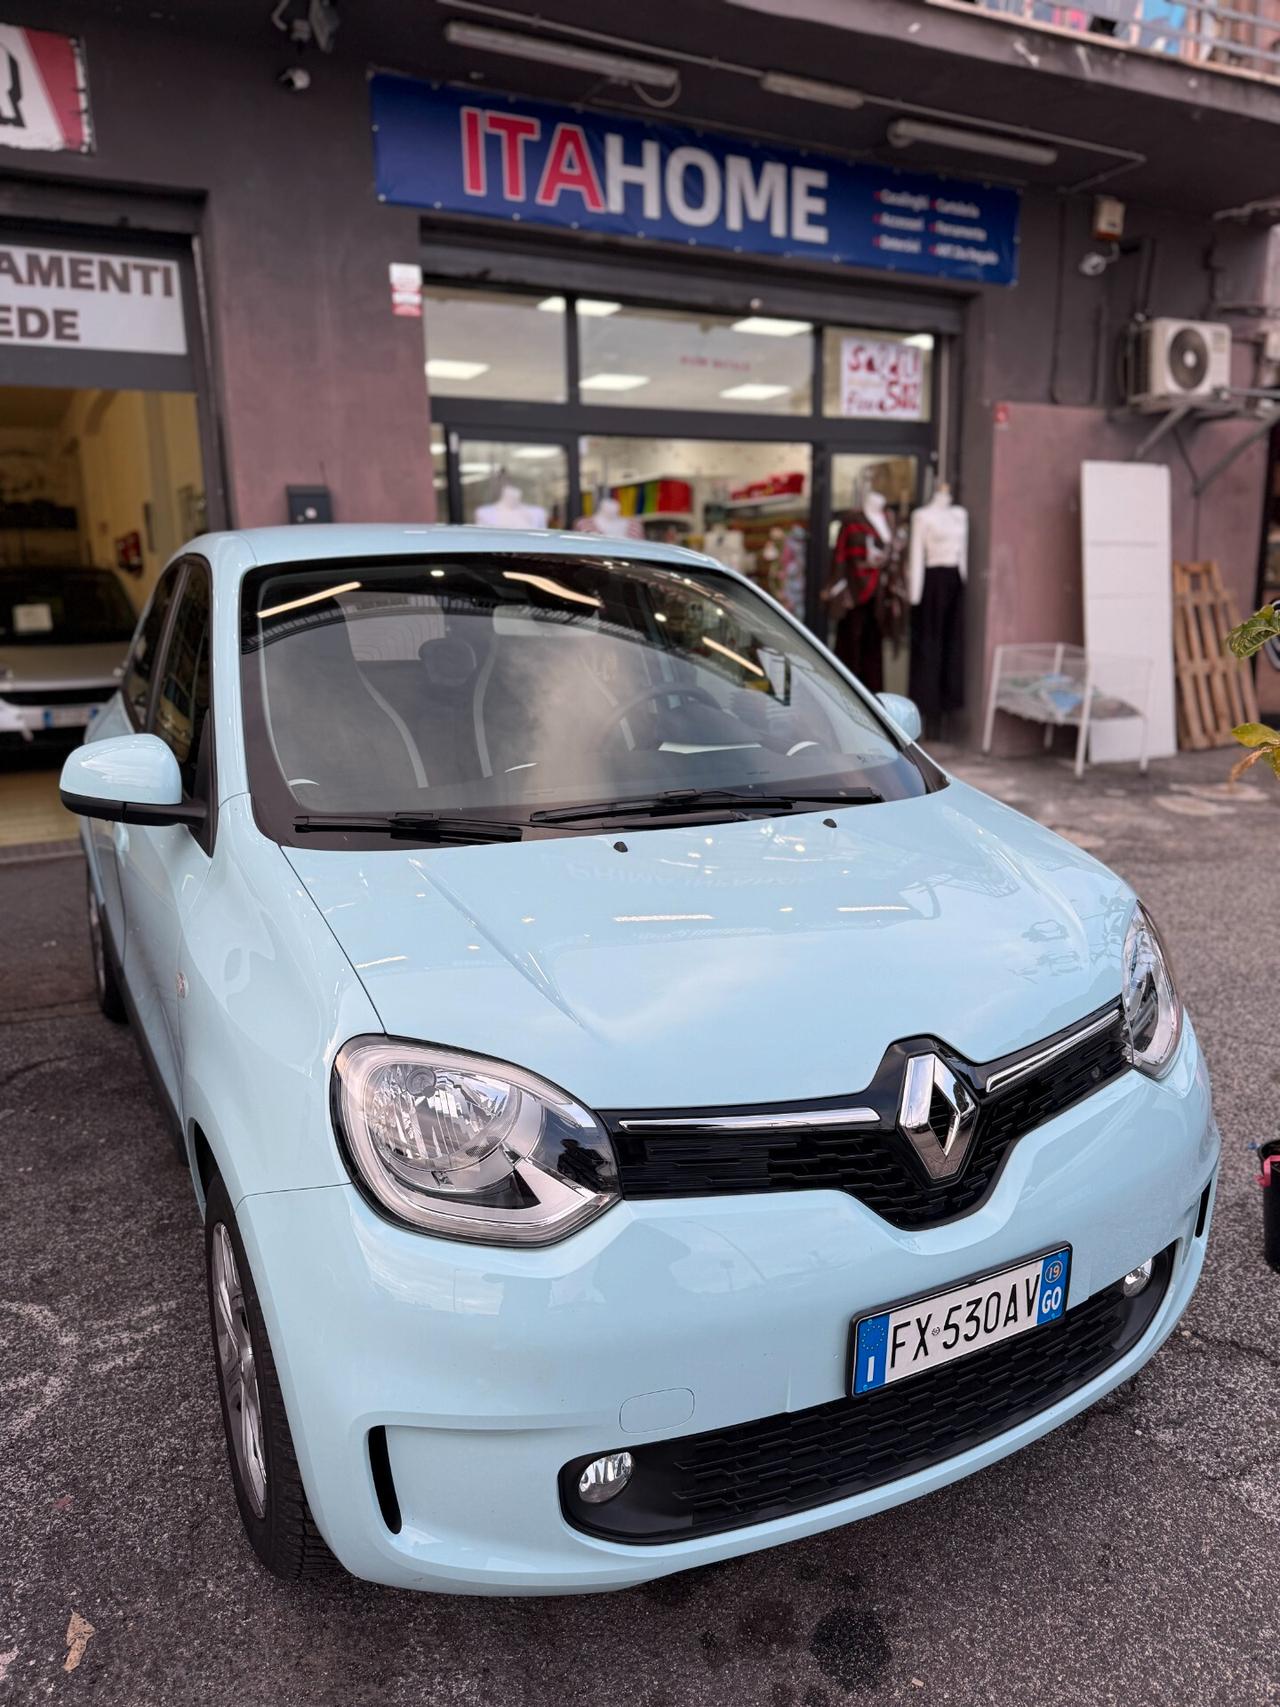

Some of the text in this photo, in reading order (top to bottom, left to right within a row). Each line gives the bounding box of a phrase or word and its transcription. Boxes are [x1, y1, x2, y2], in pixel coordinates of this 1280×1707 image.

[461, 105, 829, 244] ITAHOME
[1047, 1264, 1061, 1280] 19
[1041, 1286, 1062, 1314] GO
